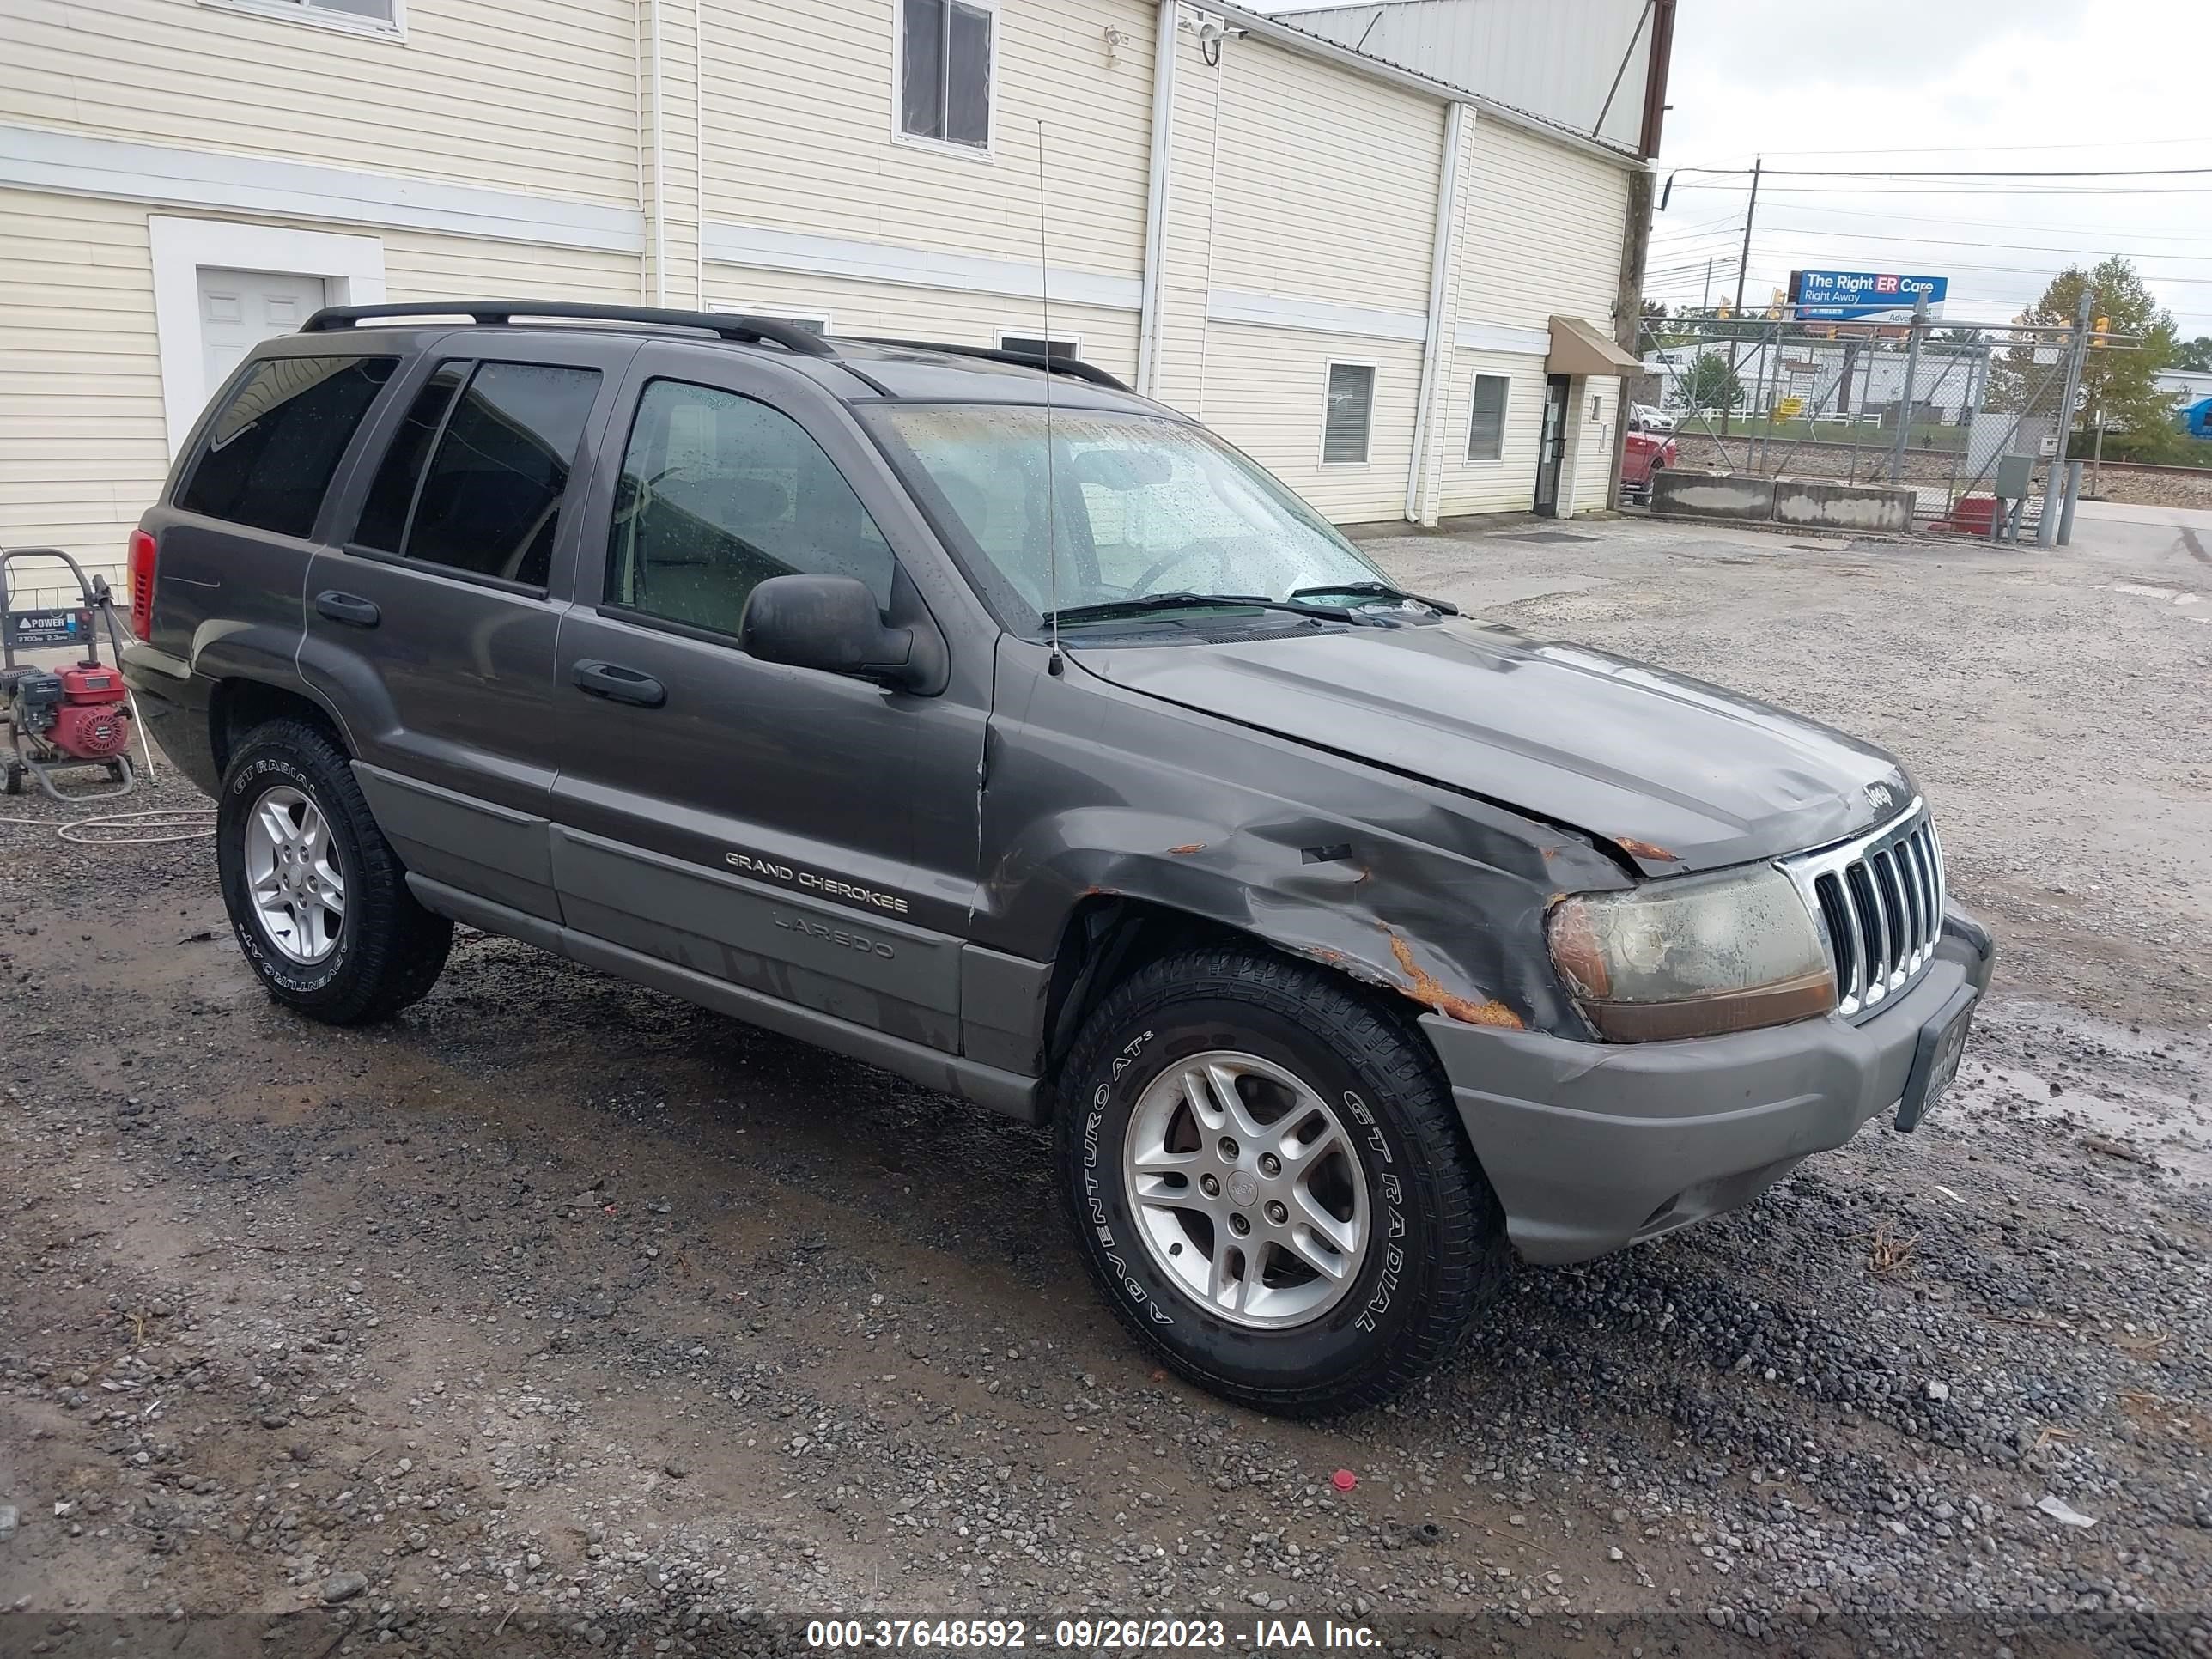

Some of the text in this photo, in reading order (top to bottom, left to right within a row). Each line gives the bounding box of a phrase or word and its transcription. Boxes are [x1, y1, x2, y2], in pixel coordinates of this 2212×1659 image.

[1805, 289, 1861, 304] Right Away
[1807, 273, 1934, 294] The Right ER Care
[234, 759, 318, 800] GT RADIAL
[725, 852, 908, 915] GRAND CHEROKEE
[774, 910, 895, 959] LAREDO
[1084, 1083, 1175, 1324] ADVENTURO
[1343, 1091, 1406, 1333] GT RADIAL
